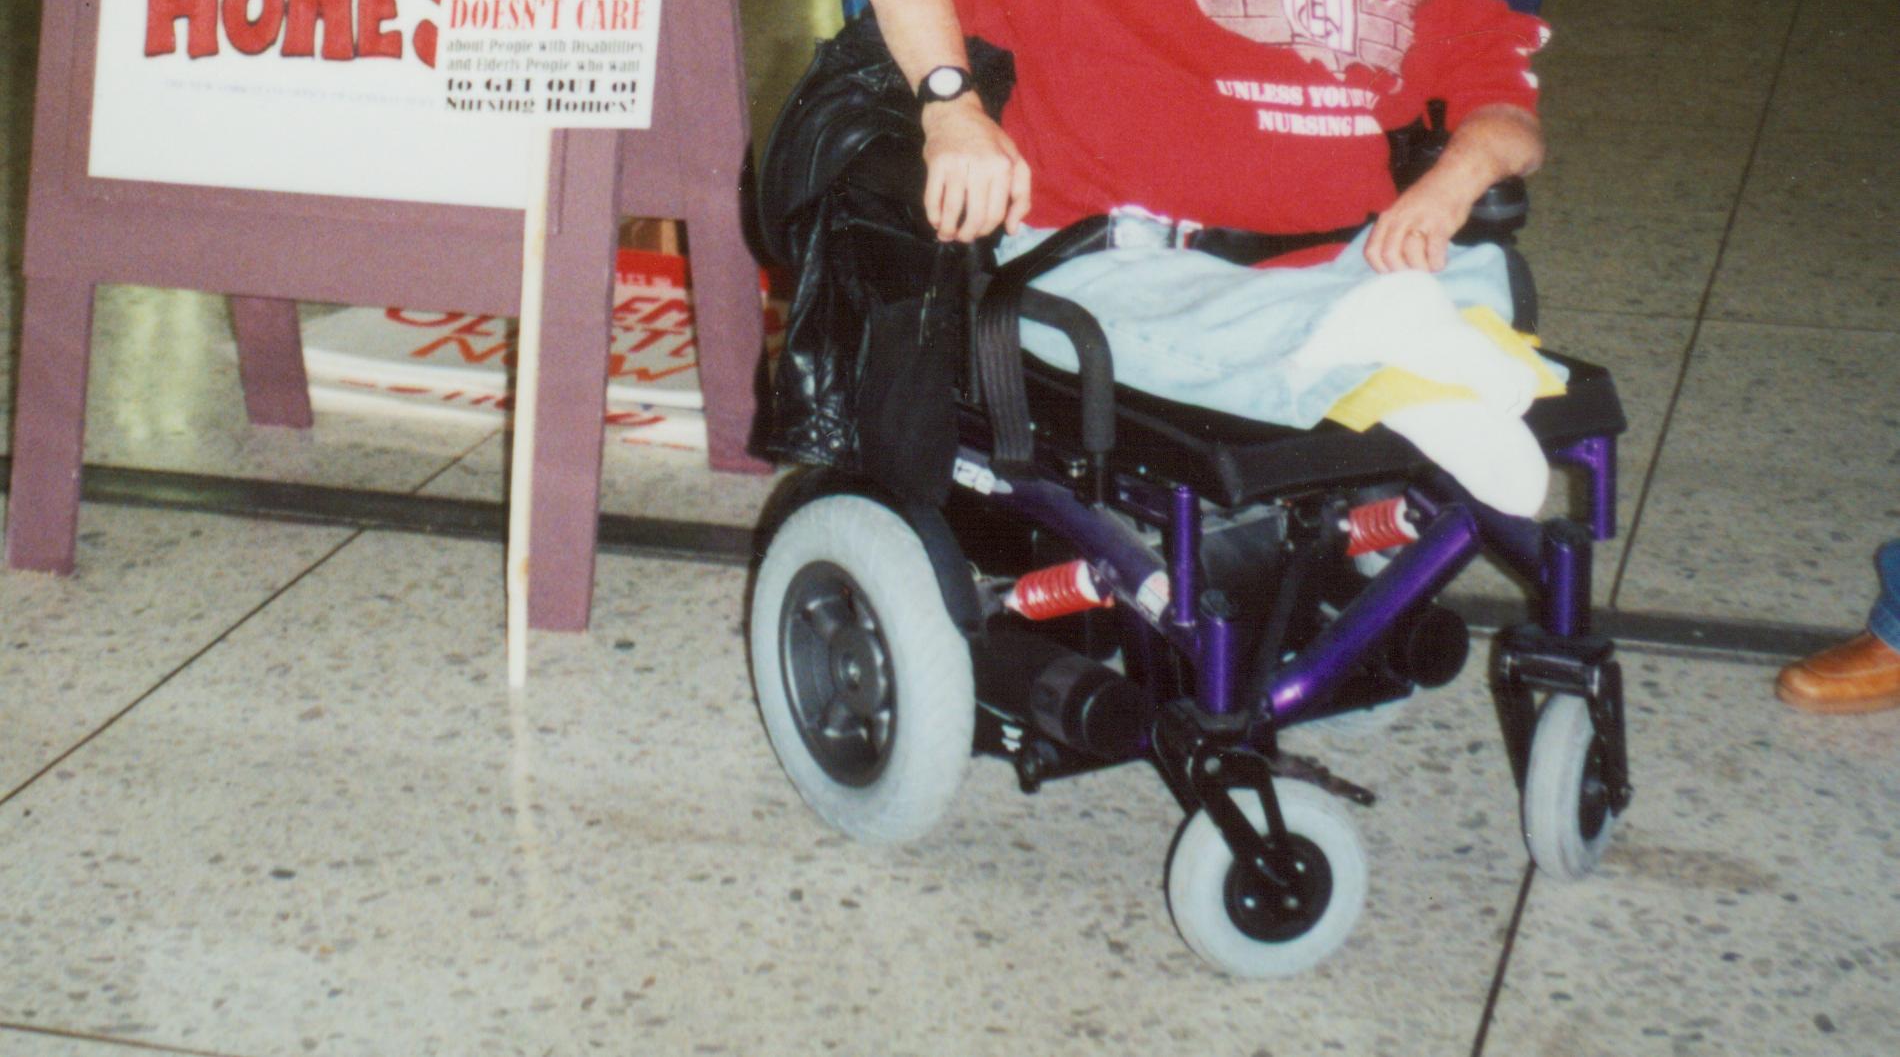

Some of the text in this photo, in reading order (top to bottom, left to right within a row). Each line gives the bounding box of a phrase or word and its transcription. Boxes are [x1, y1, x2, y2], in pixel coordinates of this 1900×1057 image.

[446, 39, 644, 54] about People with Disabilities
[446, 57, 641, 74] and Elderly People who want
[447, 78, 473, 93] to
[484, 78, 533, 93] GET
[546, 78, 599, 93] OUT
[611, 79, 638, 93] of
[1215, 79, 1304, 106] UNLESS
[446, 96, 637, 113] Nursing Homes!
[1257, 109, 1353, 137] NURSING
